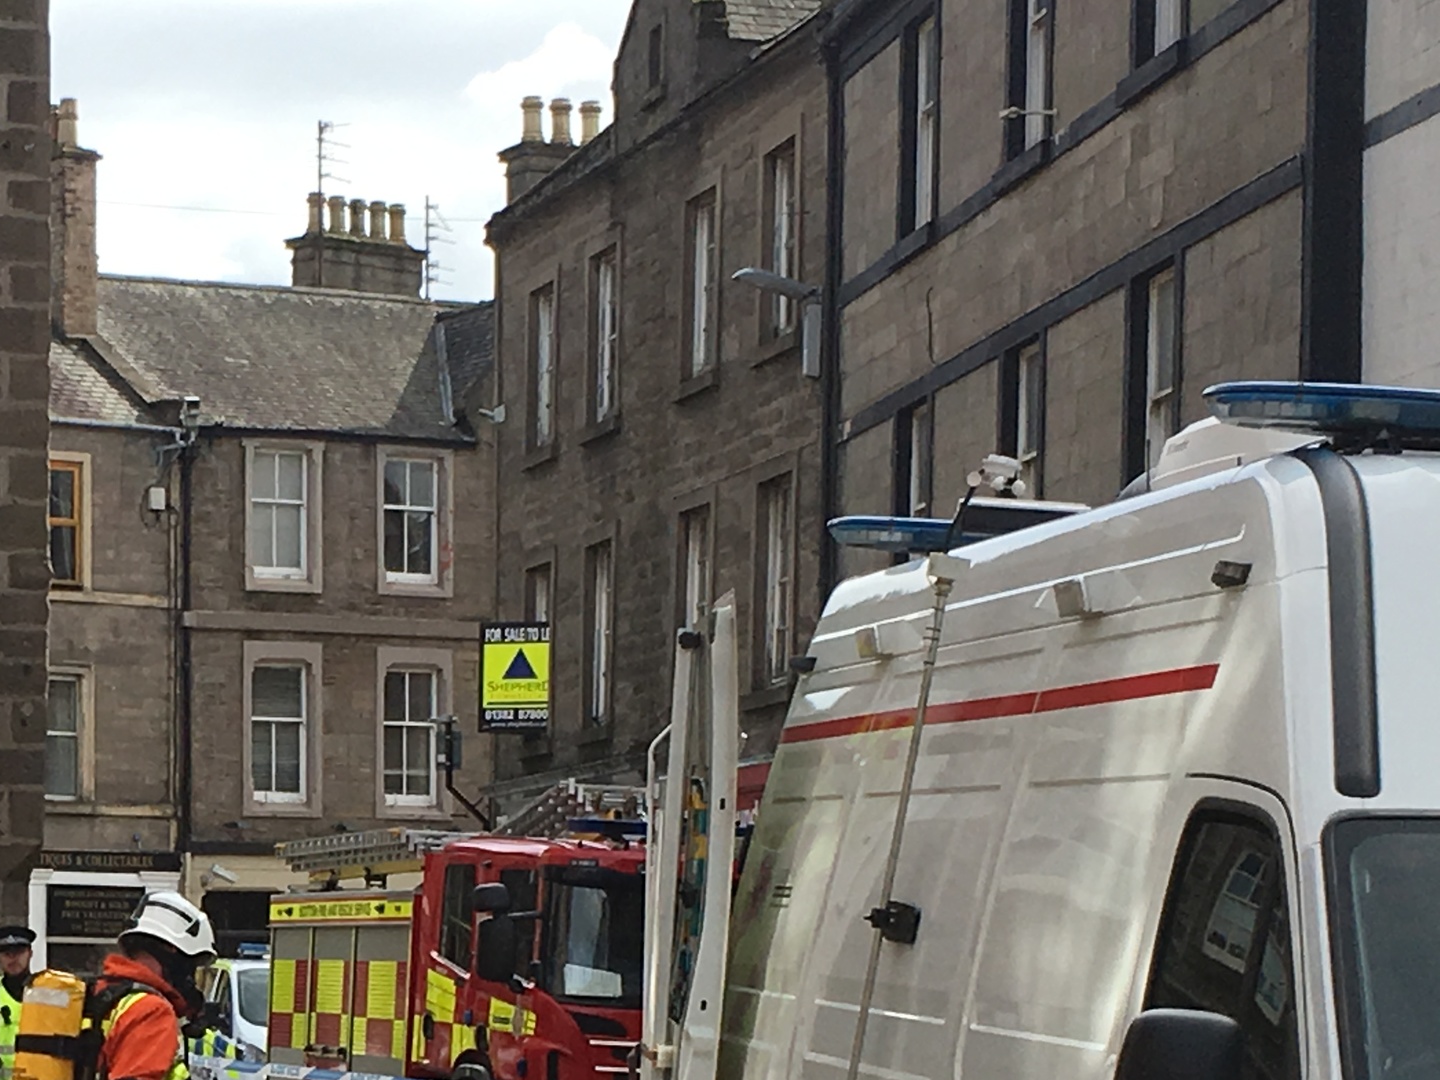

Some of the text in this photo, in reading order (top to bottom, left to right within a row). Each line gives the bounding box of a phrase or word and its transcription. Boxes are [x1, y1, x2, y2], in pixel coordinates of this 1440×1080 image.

[485, 628, 502, 642] FOR
[504, 627, 525, 642] SALE
[526, 627, 539, 641] TO
